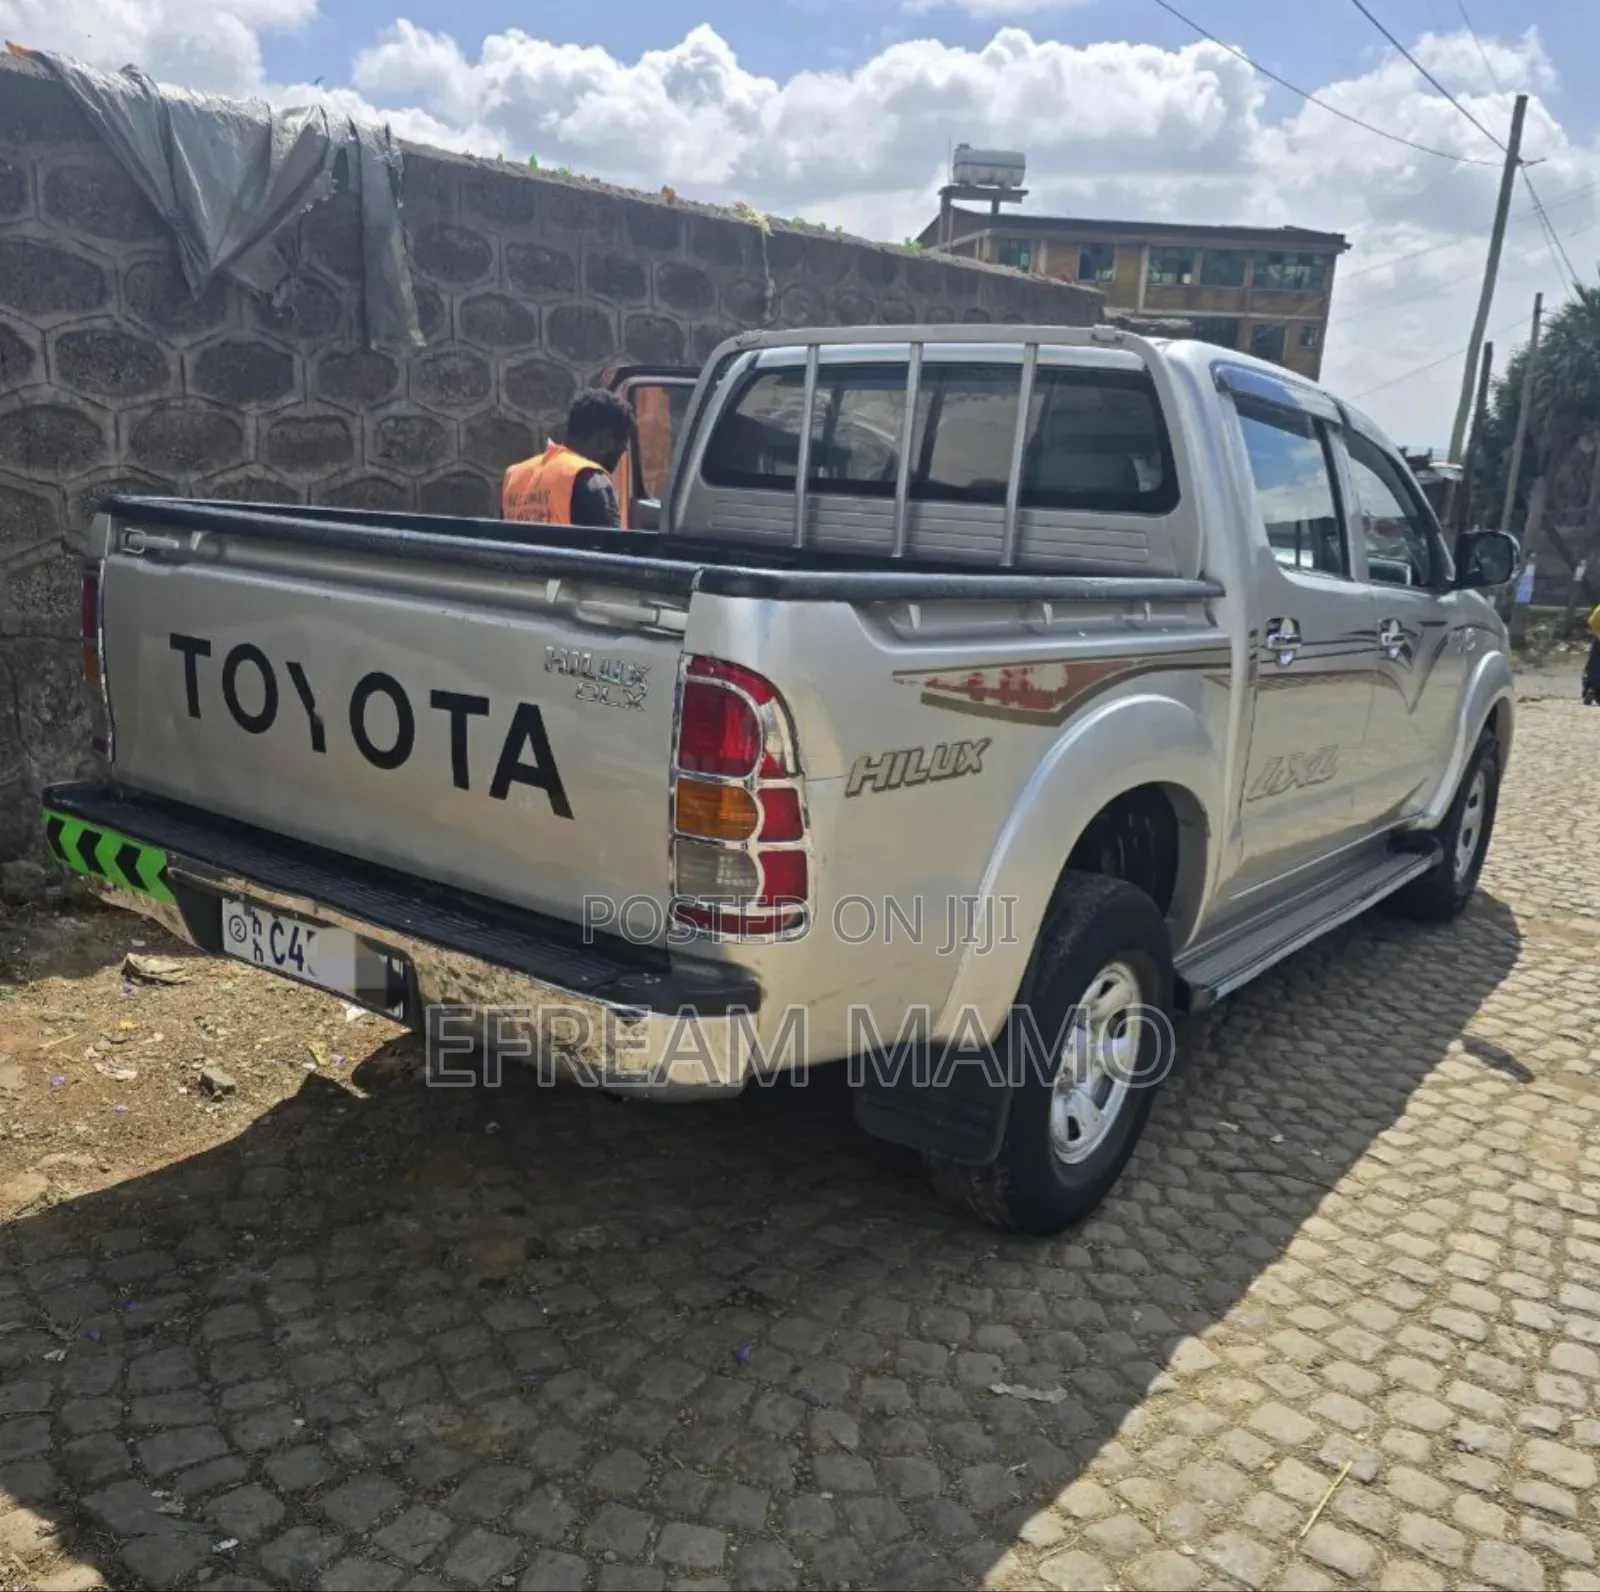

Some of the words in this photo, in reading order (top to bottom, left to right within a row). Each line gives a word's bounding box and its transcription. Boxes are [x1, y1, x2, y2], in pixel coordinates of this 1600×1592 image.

[544, 645, 651, 690] HILUX
[169, 632, 575, 821] TOYOTA
[844, 735, 992, 798] HILUX
